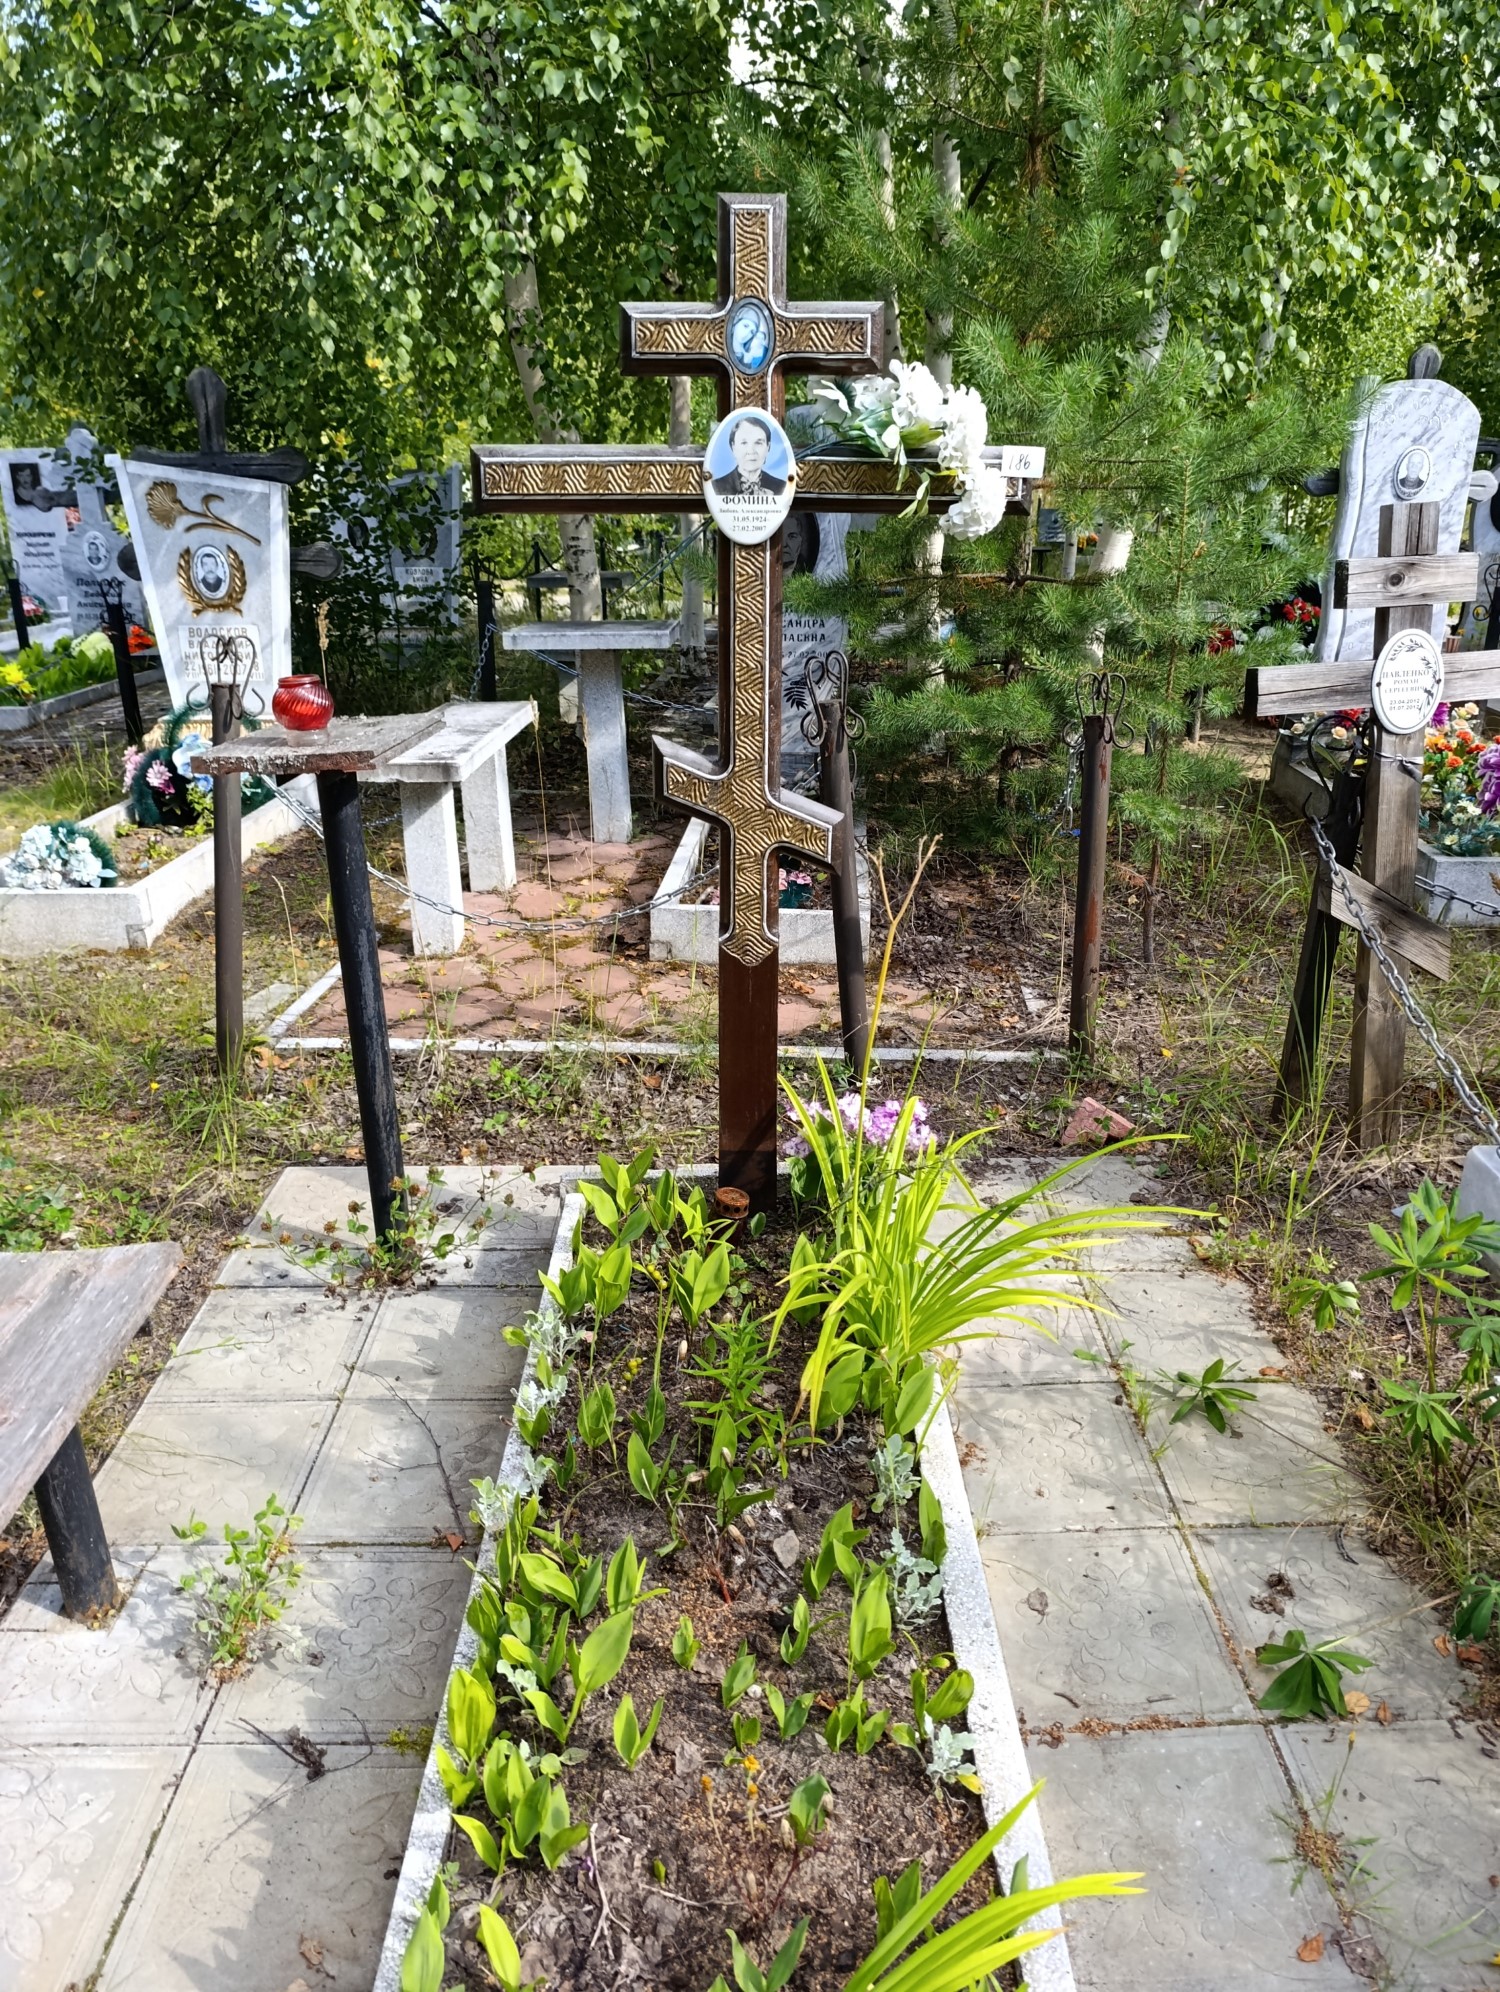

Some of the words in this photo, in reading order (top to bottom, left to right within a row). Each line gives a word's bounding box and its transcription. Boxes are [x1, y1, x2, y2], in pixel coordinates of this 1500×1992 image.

[1009, 453, 1031, 471] 186
[722, 495, 777, 505] ФОМИНА
[1382, 670, 1430, 679] ПАВЛЕНКО
